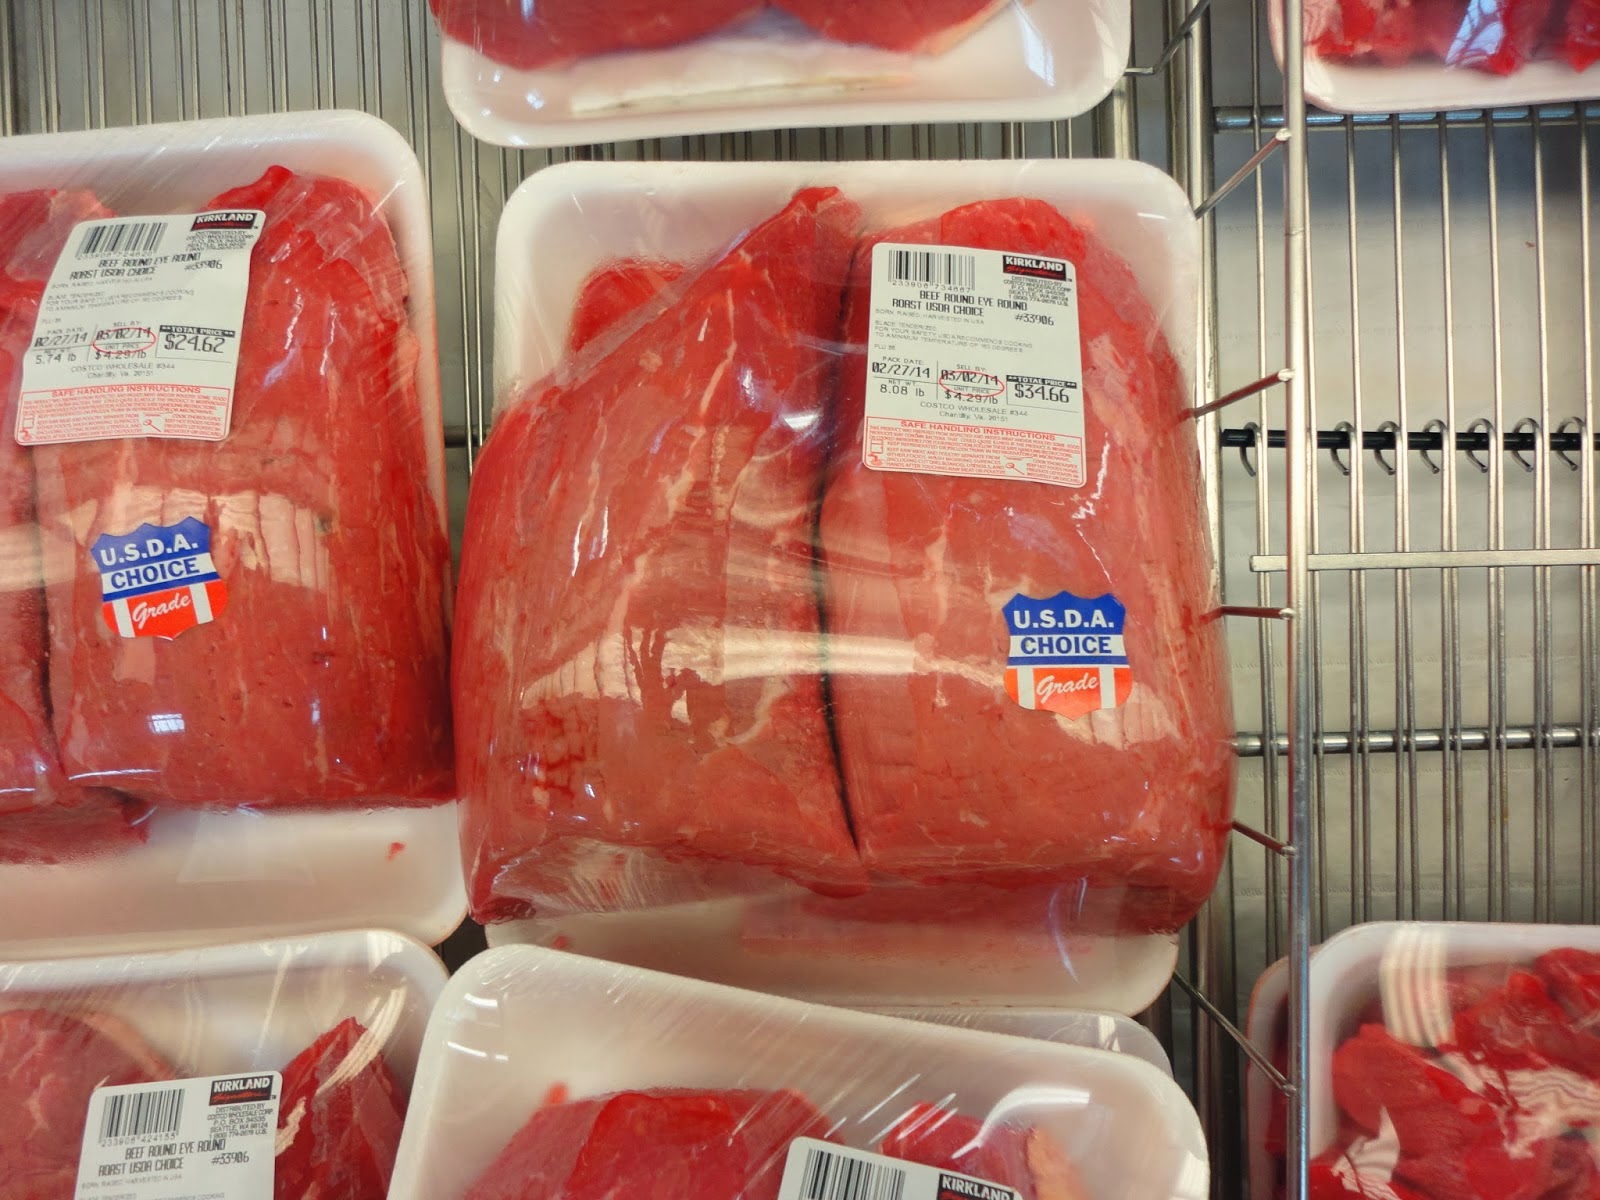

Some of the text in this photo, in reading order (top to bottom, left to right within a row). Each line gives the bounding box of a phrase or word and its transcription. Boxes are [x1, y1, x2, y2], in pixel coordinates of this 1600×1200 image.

[196, 213, 254, 223] KIRKLAND
[99, 259, 120, 268] BEEF
[122, 257, 153, 267] ROUND
[154, 255, 170, 265] EYE
[172, 252, 201, 262] ROUND
[1006, 256, 1063, 272] KIRKLAND
[69, 270, 98, 280] ROAST
[101, 268, 126, 277] USDA
[127, 267, 156, 276] CHOICE
[920, 290, 1027, 311] BEEF ROUND EYE ROUND
[892, 298, 1054, 325] ROAST USDA CHOICE #33906
[164, 332, 226, 354] $24.62
[35, 353, 62, 365] 5.74
[71, 364, 103, 373] COSTCO
[105, 362, 153, 370] WHOLESALE
[872, 362, 930, 378] 02/27/14
[51, 384, 201, 398] SAFE HANDLING INSTRUCTIONS
[880, 383, 925, 397] 8.08 lb
[1015, 383, 1069, 403] $34.66
[920, 401, 955, 410] COSTCO
[957, 404, 1007, 415] WHOLESALE
[901, 420, 926, 429] SAFE
[929, 423, 980, 434] HANDLING
[983, 428, 1056, 440] INSTRUCTIONS
[100, 533, 199, 566] U.S.D.A.
[110, 557, 200, 589] CHOICE
[132, 592, 192, 630] Grade
[1013, 609, 1115, 629] U.S.D.A.
[1020, 636, 1112, 655] CHOICE
[1036, 672, 1099, 704] Grade
[213, 1077, 271, 1093] KIRKLAND
[125, 1138, 226, 1160] BEEF ROUND EYE ROUND
[98, 1151, 249, 1177] ROAST USDA CHOICE #33906
[942, 1175, 1011, 1200] KIRKLAND
